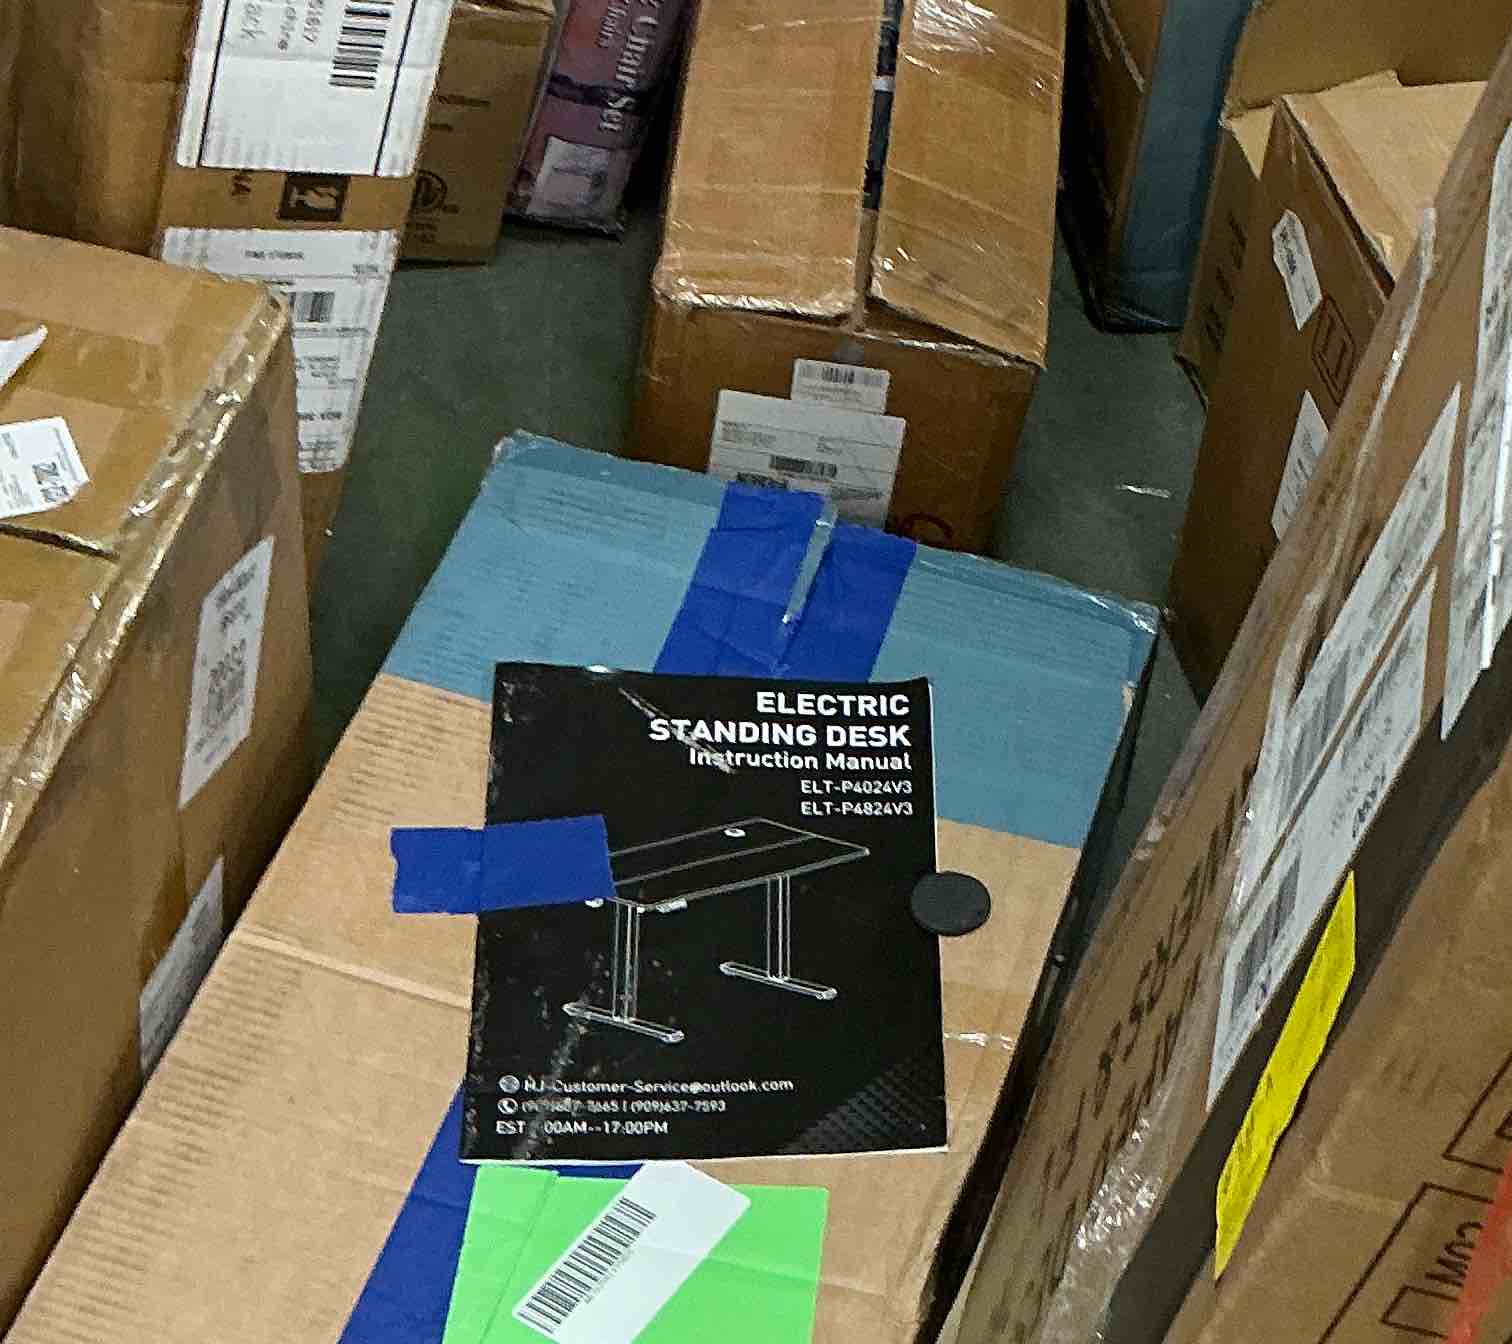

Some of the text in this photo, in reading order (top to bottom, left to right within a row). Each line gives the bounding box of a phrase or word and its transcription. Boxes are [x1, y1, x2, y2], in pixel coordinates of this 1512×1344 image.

[615, 15, 660, 92] Chair
[599, 92, 635, 133] Set
[757, 690, 911, 716] ELECTRIC
[649, 718, 912, 749] STANDING DESK
[690, 748, 912, 771] Instruction Manual
[801, 779, 913, 795] ELT-P4024V3
[801, 800, 914, 817] ELT-P4824V3
[495, 1120, 527, 1135] EST
